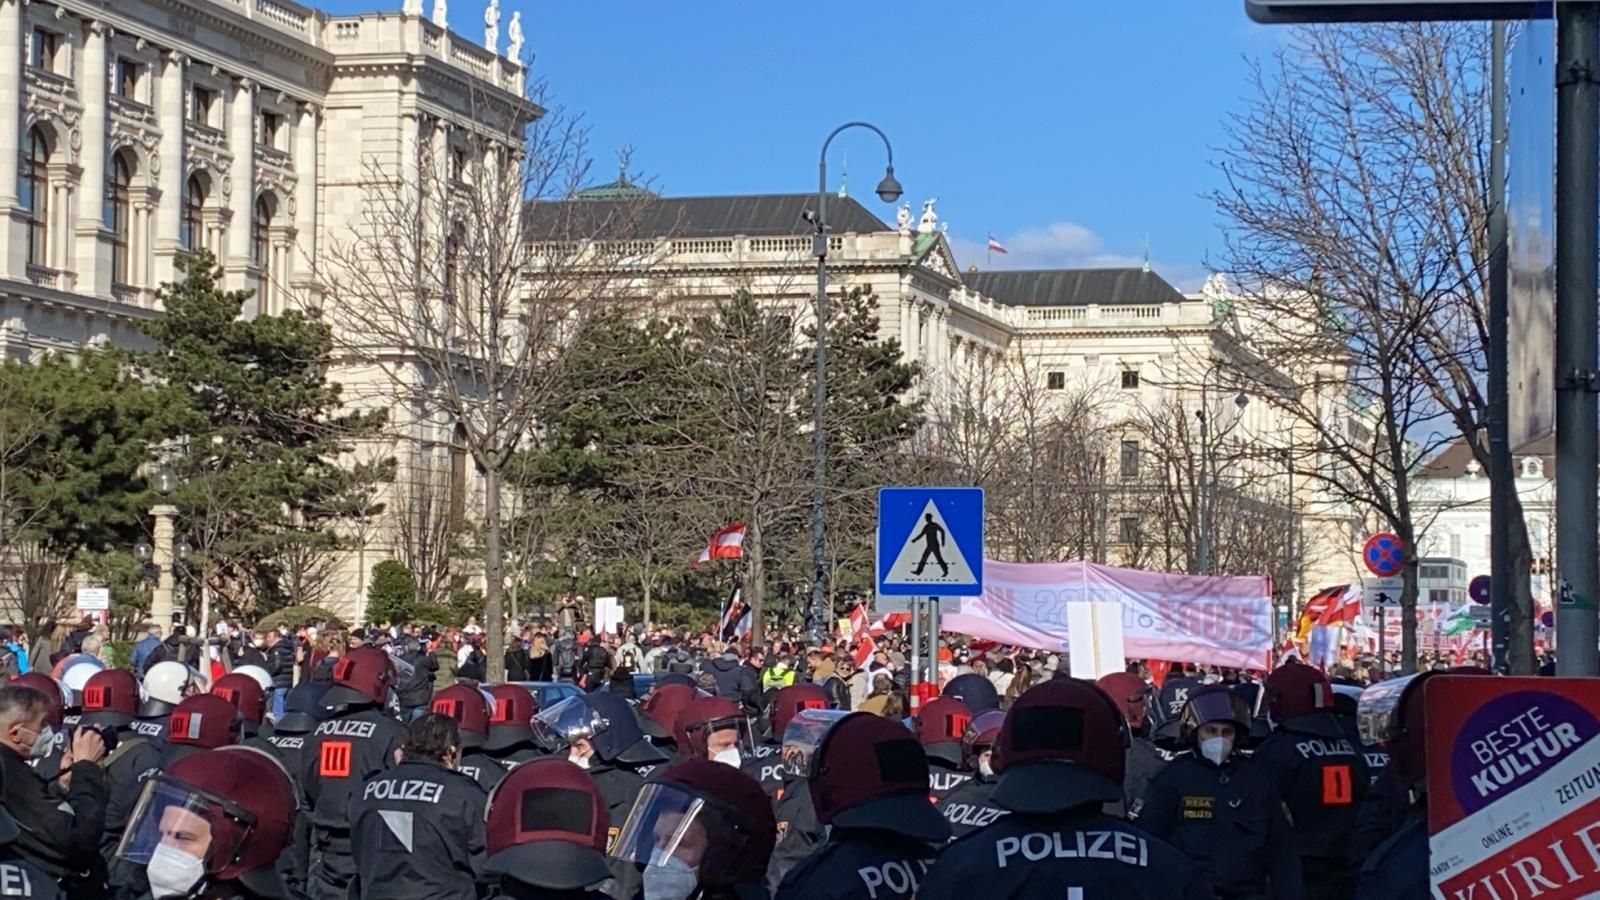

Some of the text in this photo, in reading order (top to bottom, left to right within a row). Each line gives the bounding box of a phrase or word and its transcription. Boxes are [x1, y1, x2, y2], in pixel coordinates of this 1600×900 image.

[314, 719, 377, 738] POLIZEI
[1470, 705, 1550, 765] BESTE
[1469, 721, 1582, 797] KULTUR
[363, 779, 444, 803] POLIZEI
[996, 831, 1148, 868] POLIZEI
[1481, 823, 1514, 849] ONLINE
